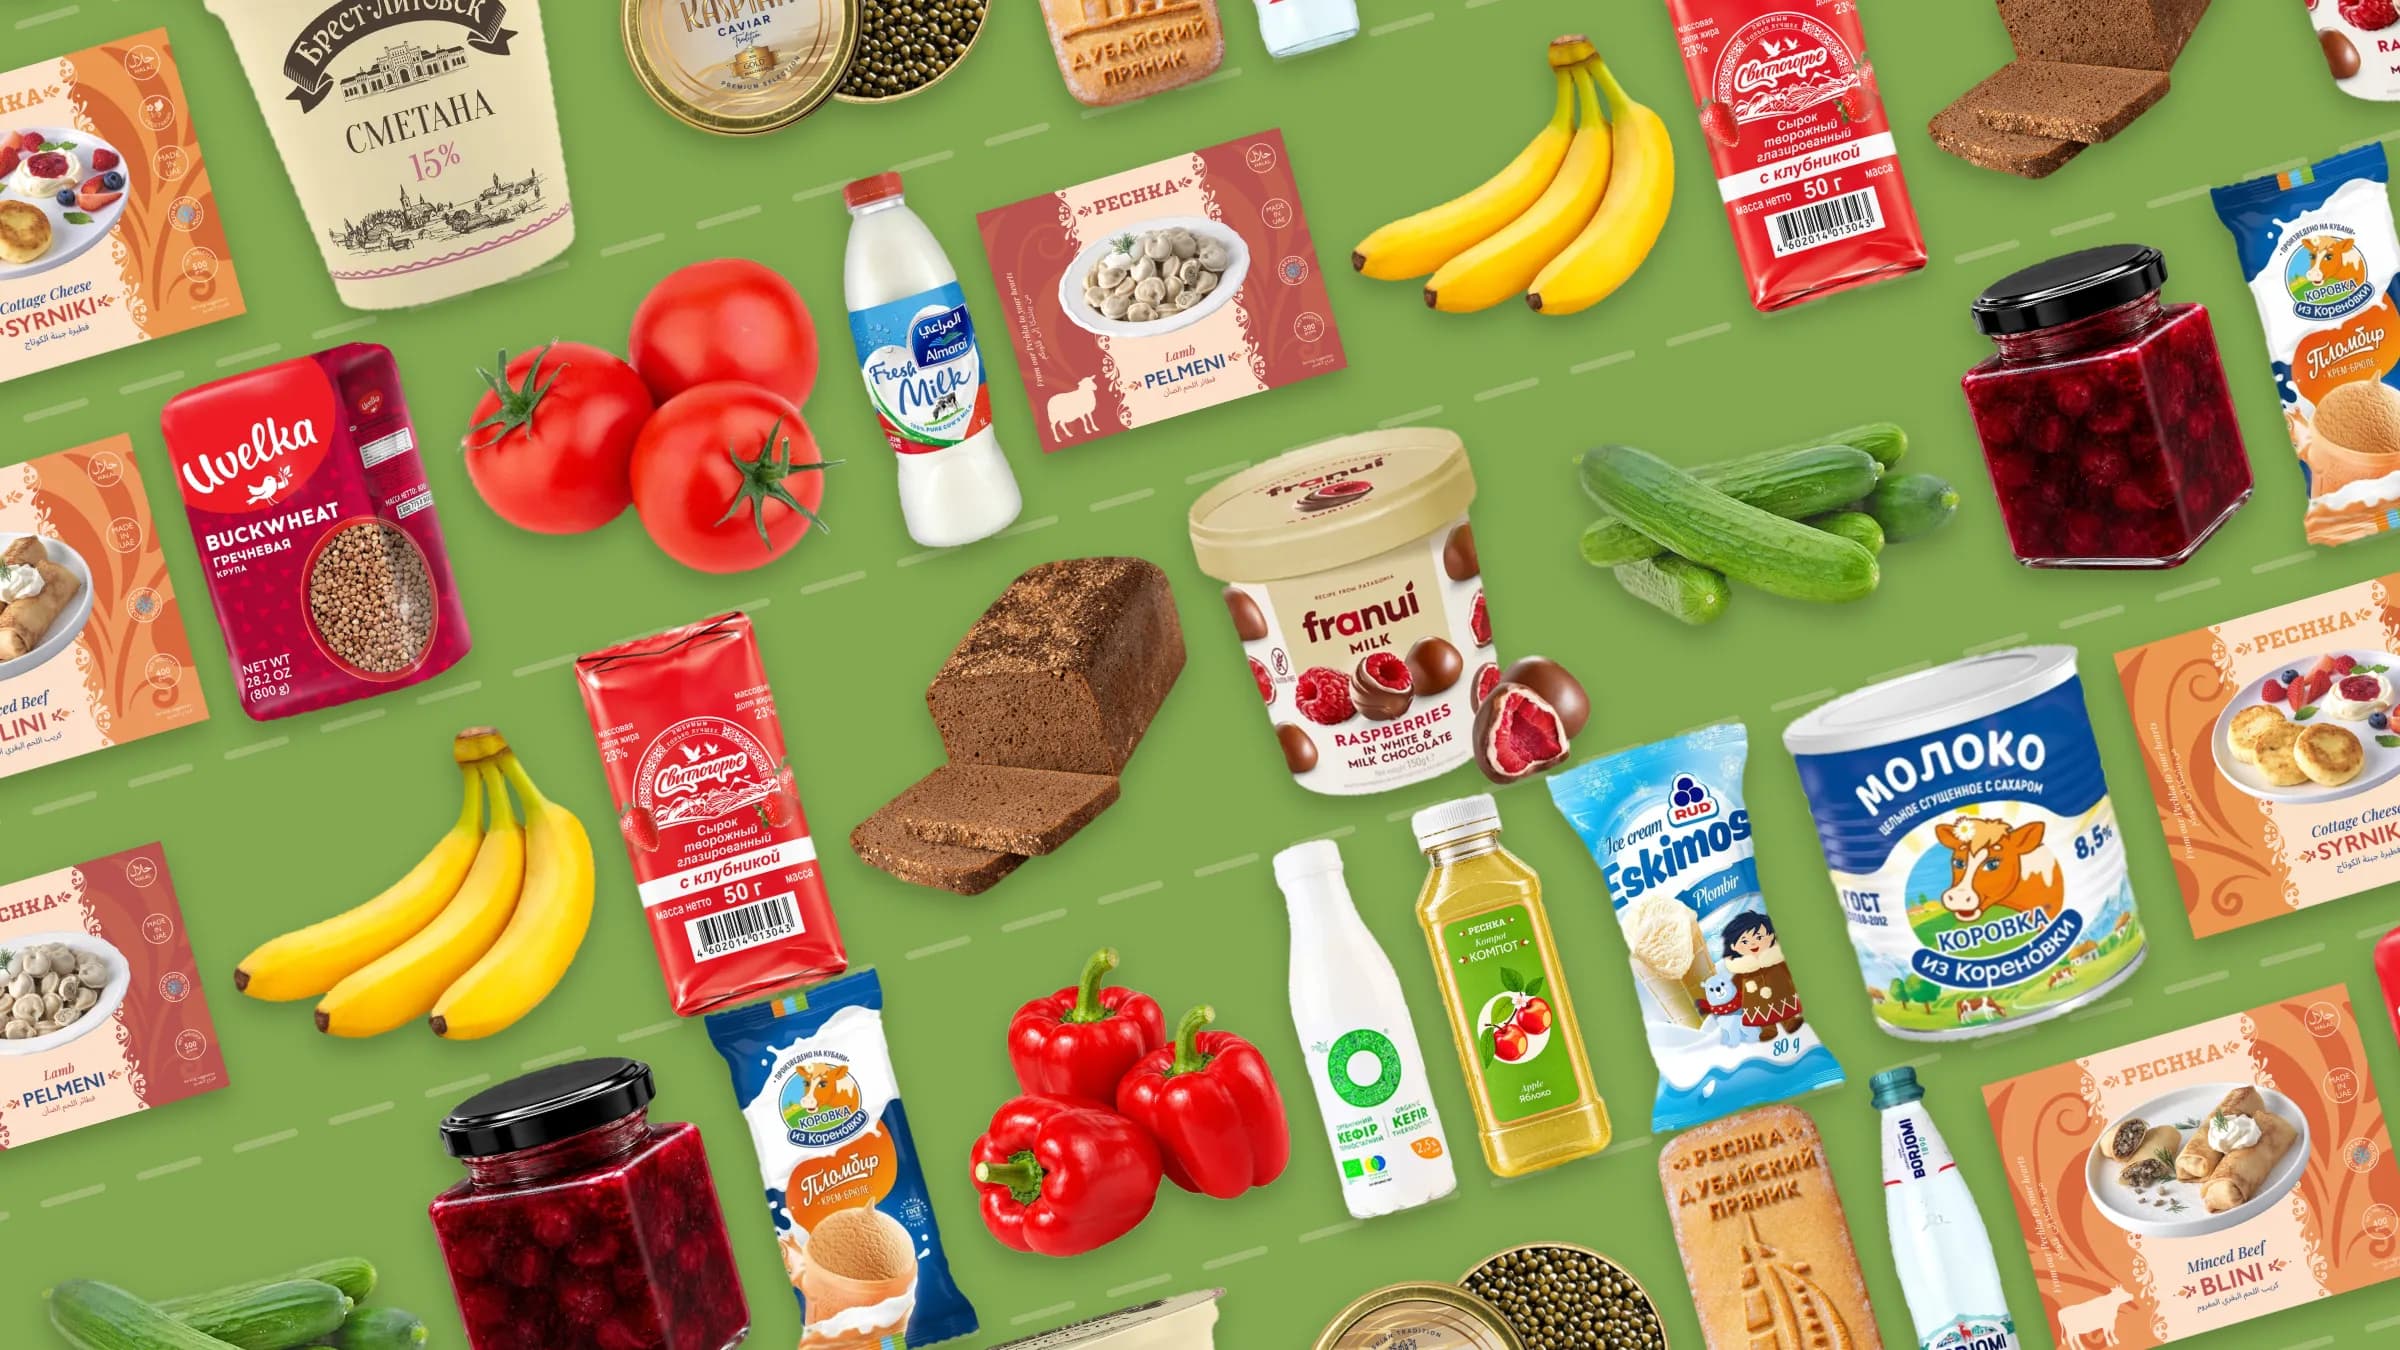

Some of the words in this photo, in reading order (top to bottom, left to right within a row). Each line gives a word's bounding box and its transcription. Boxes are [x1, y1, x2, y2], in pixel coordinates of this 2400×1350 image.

[717, 14, 771, 37] CAVIAR
[1072, 17, 1207, 71] ДУБАЙСКИЙ
[1683, 43, 1708, 59] 23%
[762, 55, 801, 87] SELECTION
[1103, 50, 1188, 87] ПРЯНИК
[720, 80, 759, 90] PREMIUM
[345, 88, 497, 154] СМЕТАНА
[1764, 118, 1838, 149] творожный
[1777, 112, 1818, 132] Сырок
[1756, 127, 1852, 163] глазированный
[408, 140, 461, 182] 15%
[1759, 172, 1769, 184] с
[1773, 143, 1861, 182] клубникой
[1865, 162, 1894, 179] масса
[1093, 178, 1180, 216] PECHKA
[1803, 177, 1829, 199] 50
[1833, 176, 1843, 191] г
[1735, 201, 1765, 216] масса
[1765, 192, 1792, 208] нетто
[2281, 223, 2319, 255] ПРОИЗВЕДЕНО
[2319, 222, 2328, 231] НА
[0, 293, 47, 316] Cottage
[50, 279, 93, 301] Cheese
[2304, 278, 2358, 303] КОРОВКА
[5, 297, 97, 338] SYRNIKI
[918, 311, 962, 340] المراعي
[925, 336, 968, 363] Almarai
[1164, 345, 1196, 365] Lamb
[2307, 325, 2385, 380] Пломбир
[869, 359, 918, 385] Fresh
[1144, 353, 1226, 390] PELMENI
[2327, 357, 2375, 379] КРЕМ-БРЮЛЕ
[898, 367, 972, 416] Milk
[181, 417, 319, 494] Uvelka
[111, 523, 135, 534] MADE
[205, 502, 339, 552] BUCKWHEAT
[213, 538, 292, 568] ГРЕЧНЕВАЯ
[216, 564, 248, 579] КРУПА
[1348, 632, 1393, 656] MILK
[2253, 610, 2356, 654] PECHKA
[242, 658, 268, 675] NET
[269, 653, 291, 669] WT
[246, 671, 271, 689] 28.2
[273, 667, 293, 681] OZ
[21, 688, 50, 710] Beef
[250, 685, 277, 703] (800
[278, 682, 291, 697] g)
[1334, 703, 1453, 748] RASPBERRIES
[604, 747, 629, 764] 23%
[1347, 753, 1378, 769] MILK
[1381, 730, 1453, 764] CHOCOLATE
[1362, 745, 1377, 756] IN
[1380, 732, 1420, 752] WHITE
[1422, 728, 1433, 739] &
[1855, 730, 2046, 817] МОЛОКО
[1674, 802, 1712, 821] RUD
[1879, 801, 1920, 837] ЦЕЛЬНОЕ
[1920, 782, 1984, 811] СГУЩЕННОЕ
[1984, 780, 1993, 793] С
[1994, 778, 2044, 795] САХАРОМ
[683, 824, 759, 853] творожный
[697, 817, 739, 837] Сырок
[1604, 837, 1626, 857] Ice
[1627, 818, 1663, 846] cream
[2073, 823, 2113, 860] 8,5%
[2311, 816, 2359, 839] Cottage
[676, 833, 773, 869] глазированный
[1602, 809, 1751, 910] Eskimos
[679, 877, 690, 889] с
[693, 848, 781, 886] клубникой
[785, 866, 814, 884] масса
[723, 882, 750, 905] 50
[754, 880, 764, 896] г
[1693, 874, 1740, 909] Plombir
[1842, 889, 1881, 914] ГОСТ
[655, 904, 685, 921] масса
[686, 896, 713, 913] нетто
[1467, 917, 1507, 937] PECHKA
[1475, 931, 1508, 948] Kompot
[1937, 907, 2050, 953] КОРОВКА
[1469, 939, 1521, 963] КОМПОТ
[1773, 1040, 1789, 1057] 80
[1793, 1036, 1801, 1054] g
[43, 1062, 75, 1081] Lamb
[775, 1051, 813, 1081] ПРОИЗВЕДЕНО
[813, 1050, 822, 1058] НА
[2121, 1043, 2225, 1087] PECHKA
[2328, 1072, 2352, 1084] MADE
[22, 1071, 106, 1108] PELMENI
[1519, 1088, 1553, 1104] Яблоко
[1520, 1079, 1545, 1094] Apple
[799, 1106, 851, 1130] КОРОВКА
[1391, 1106, 1429, 1129] KEFIR
[1337, 1123, 1379, 1145] КЕФІР
[1692, 1128, 1785, 1168] PECHKA
[1918, 1136, 1930, 1156] 1890
[1898, 1118, 1926, 1180] BORJOMI
[801, 1151, 879, 1207] Пломбир
[1679, 1147, 1820, 1207] ДУБАЙСКИЙ
[821, 1184, 870, 1207] КРЕМ-БРЮЛЕ
[1708, 1180, 1803, 1222] ПРЯНИК
[2186, 1249, 2235, 1275] Minced
[2238, 1239, 2267, 1261] Beef
[2199, 1262, 2264, 1296] BLINI
